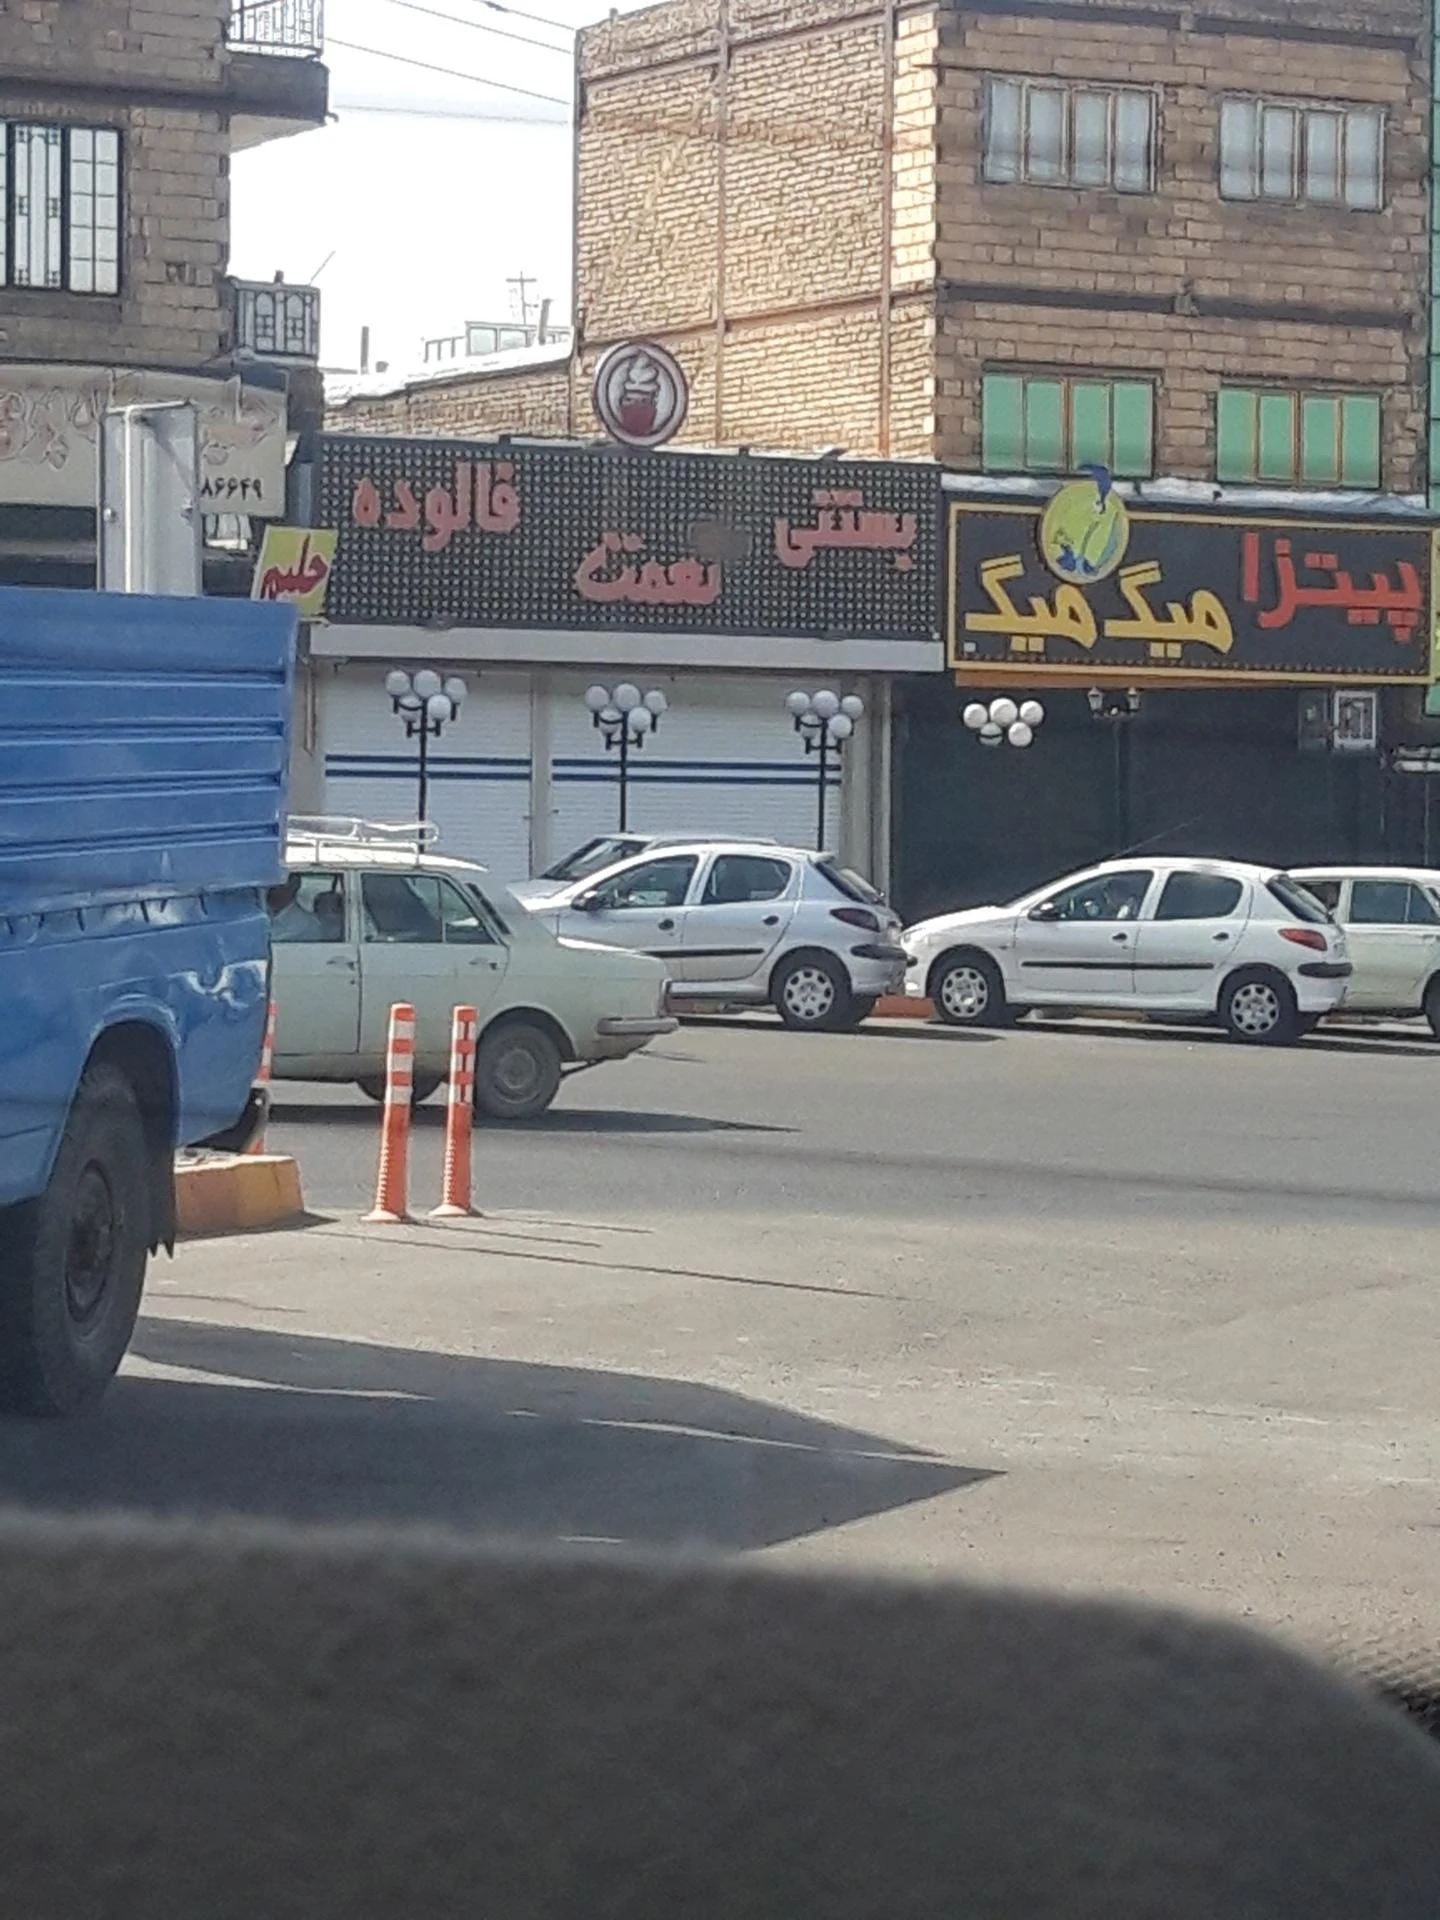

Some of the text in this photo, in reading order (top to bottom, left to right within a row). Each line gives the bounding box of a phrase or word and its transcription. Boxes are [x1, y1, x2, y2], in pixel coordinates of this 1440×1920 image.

[354, 462, 521, 551] فالوده
[774, 490, 916, 572] بستنی
[965, 532, 1423, 658] پیتزا میگ میگ
